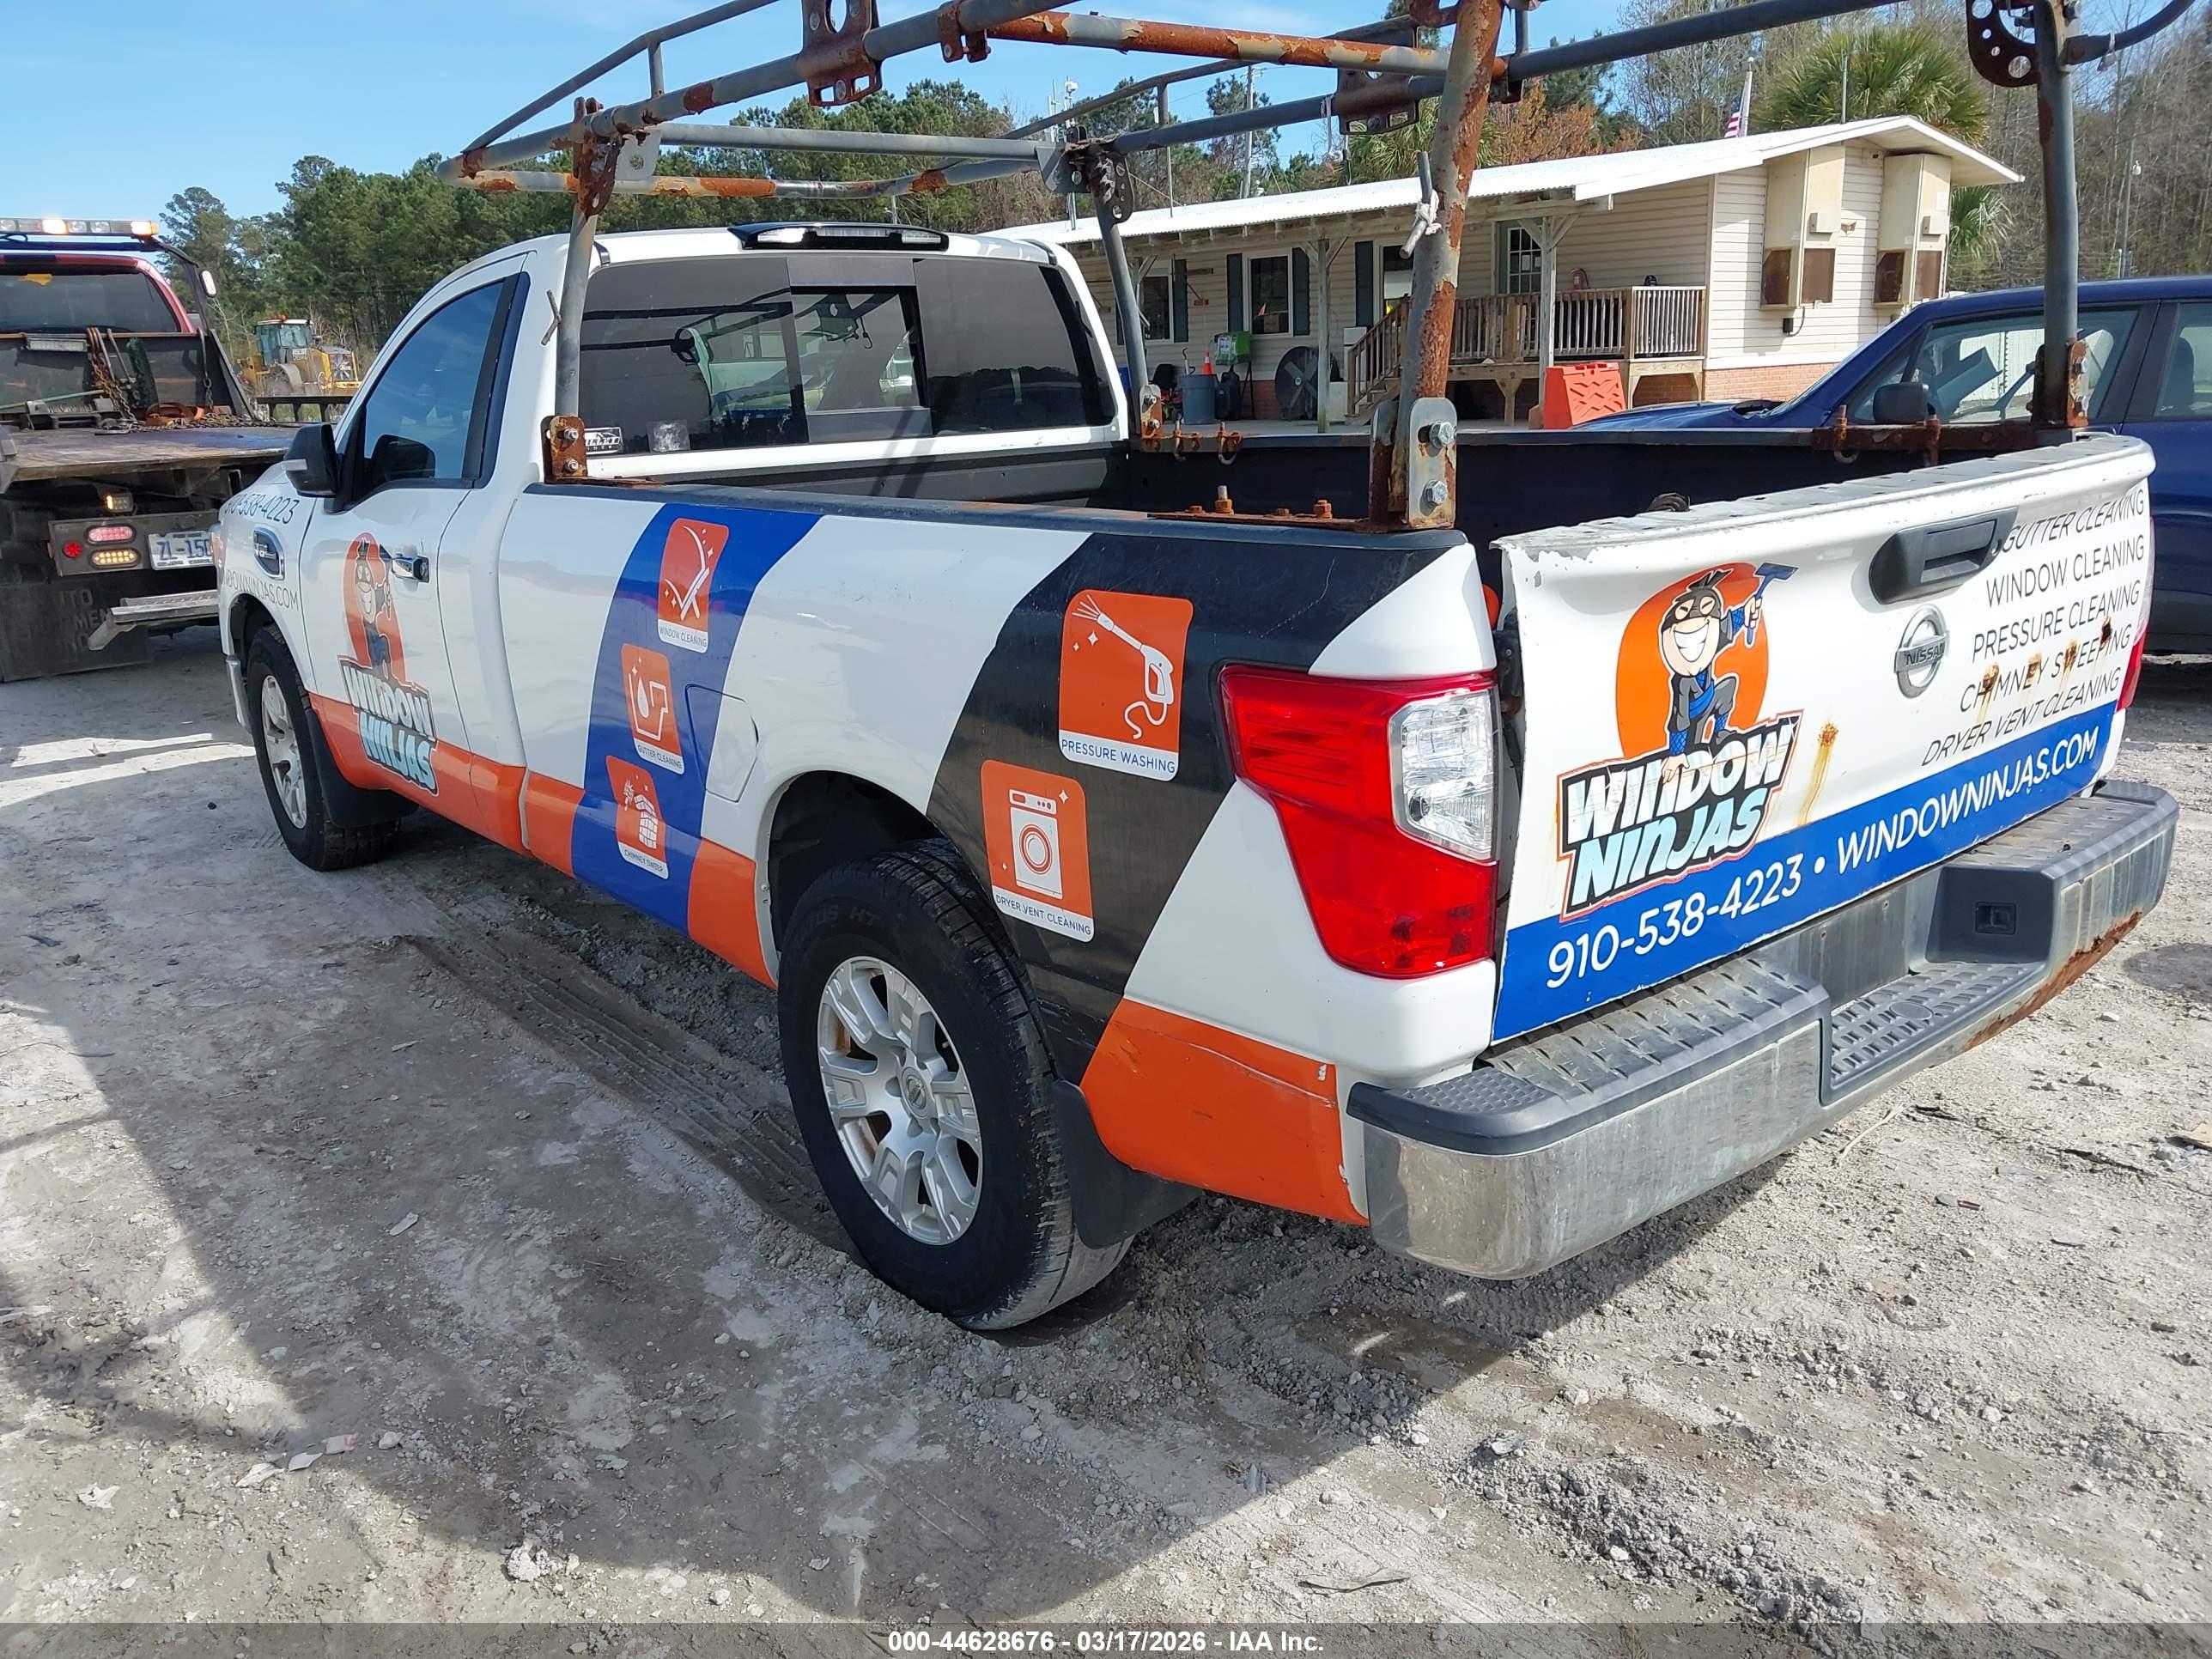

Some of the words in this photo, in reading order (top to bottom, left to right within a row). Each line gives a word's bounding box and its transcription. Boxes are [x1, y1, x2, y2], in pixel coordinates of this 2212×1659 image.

[2002, 511, 2072, 554] GUTTER
[2075, 489, 2145, 533] CLEANING
[1986, 557, 2068, 608] WINDOW
[2073, 534, 2145, 581] CLEANING
[659, 626, 679, 640] WINDOW
[680, 632, 708, 647] CLEANING
[1905, 641, 1947, 668] NISSAN
[1972, 606, 2065, 664] PRESSURE
[2069, 580, 2141, 629] CLEANING
[343, 665, 436, 738] WINDOW
[1922, 720, 1993, 767] DRYER
[1995, 700, 2045, 738] VENT
[2043, 666, 2122, 717] CLEANING
[359, 711, 436, 791] NINJAS
[656, 752, 684, 769] CLEANING
[1061, 738, 1117, 762] PRESSURE
[1121, 751, 1176, 775] WASHING
[1566, 723, 1800, 845] WINDOW
[1547, 854, 1804, 990] 910-538-4223
[1837, 725, 2100, 875] WINDOWNINJAS.COM
[1571, 787, 1769, 908] NINJAS
[995, 894, 1022, 913] DRYER
[1023, 906, 1045, 921] VENT
[1047, 913, 1091, 935] CLEANING
